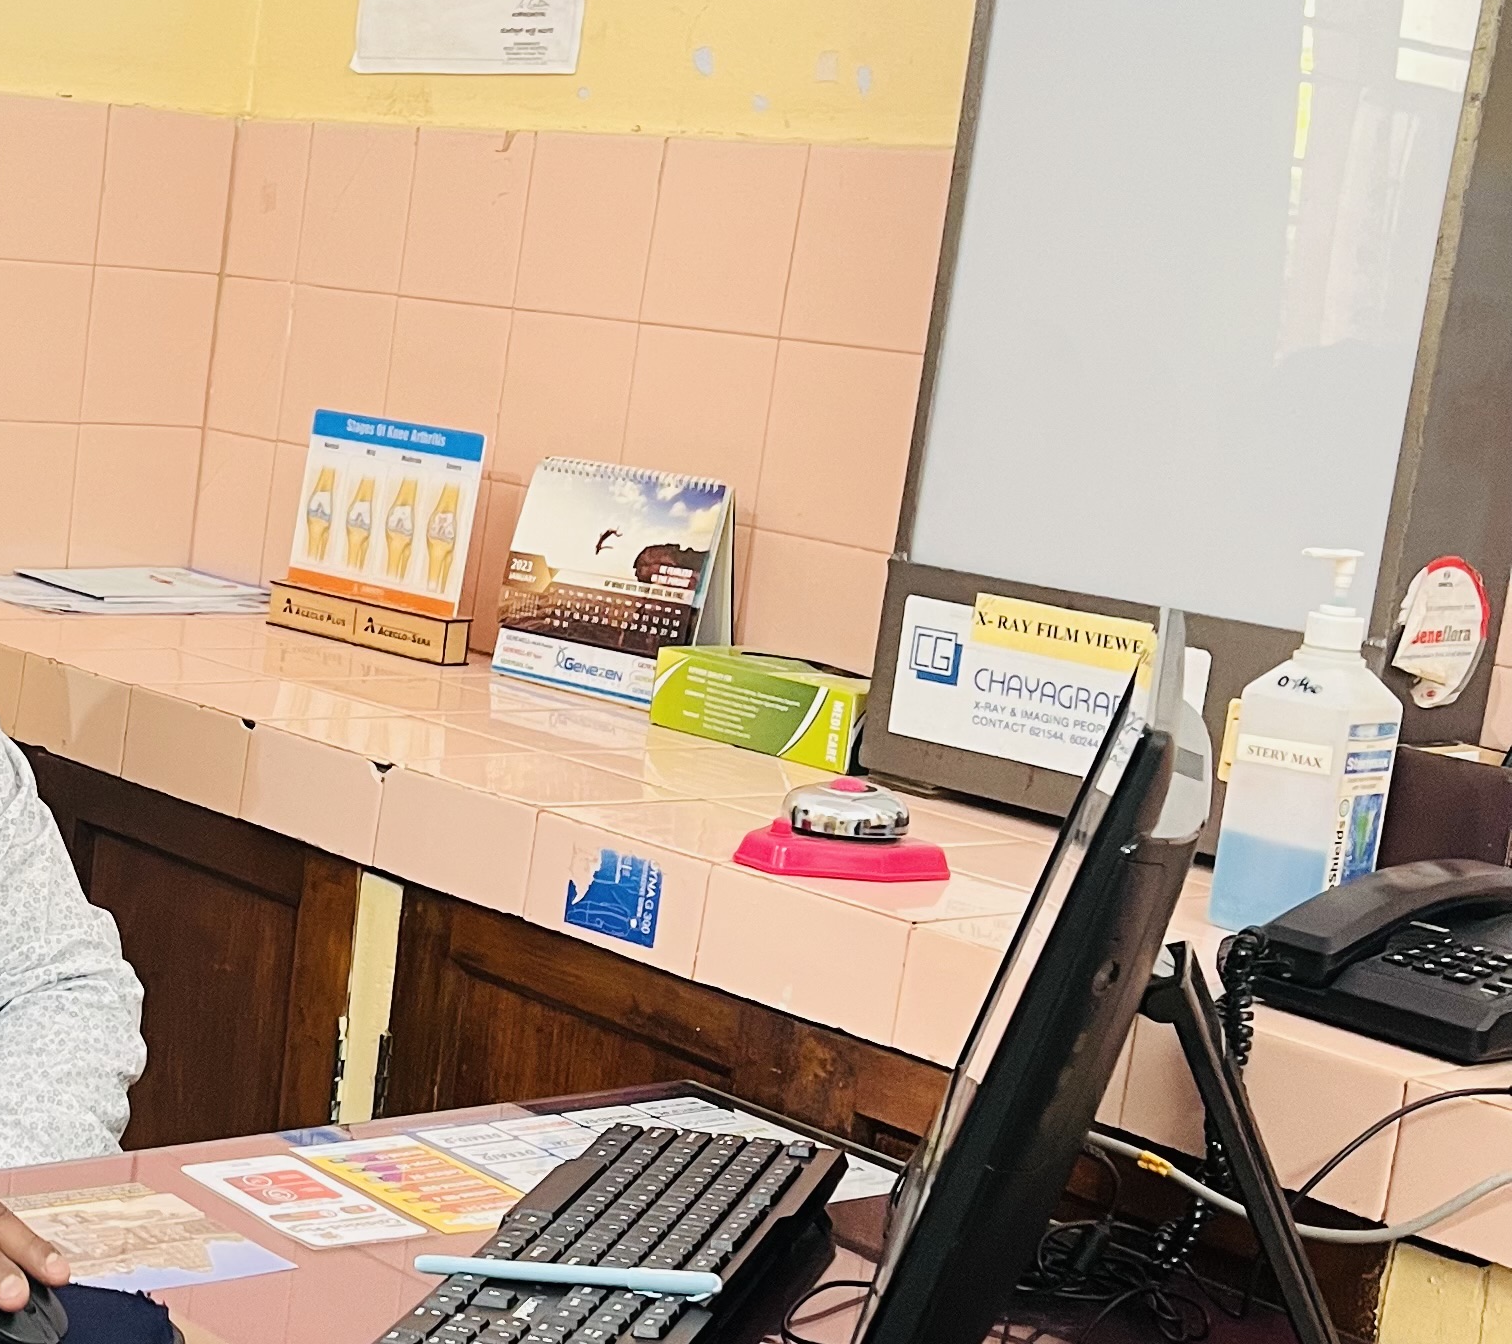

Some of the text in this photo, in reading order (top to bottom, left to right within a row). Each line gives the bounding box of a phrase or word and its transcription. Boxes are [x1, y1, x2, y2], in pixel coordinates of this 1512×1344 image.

[346, 419, 446, 447] Stages Of Knee Arthritis
[510, 558, 533, 573] 2023
[997, 615, 1032, 634] RAY
[1036, 622, 1079, 643] FILM
[1084, 630, 1145, 654] VIEWE
[914, 633, 953, 672] CG
[973, 701, 1006, 715] X-RAY
[1010, 707, 1017, 718] &
[1021, 709, 1069, 728] IMAGING
[826, 700, 845, 763] MEDI CARE
[972, 715, 1025, 733] CONTACT
[1069, 734, 1099, 749] 60244
[1246, 744, 1324, 769] STERY MAX
